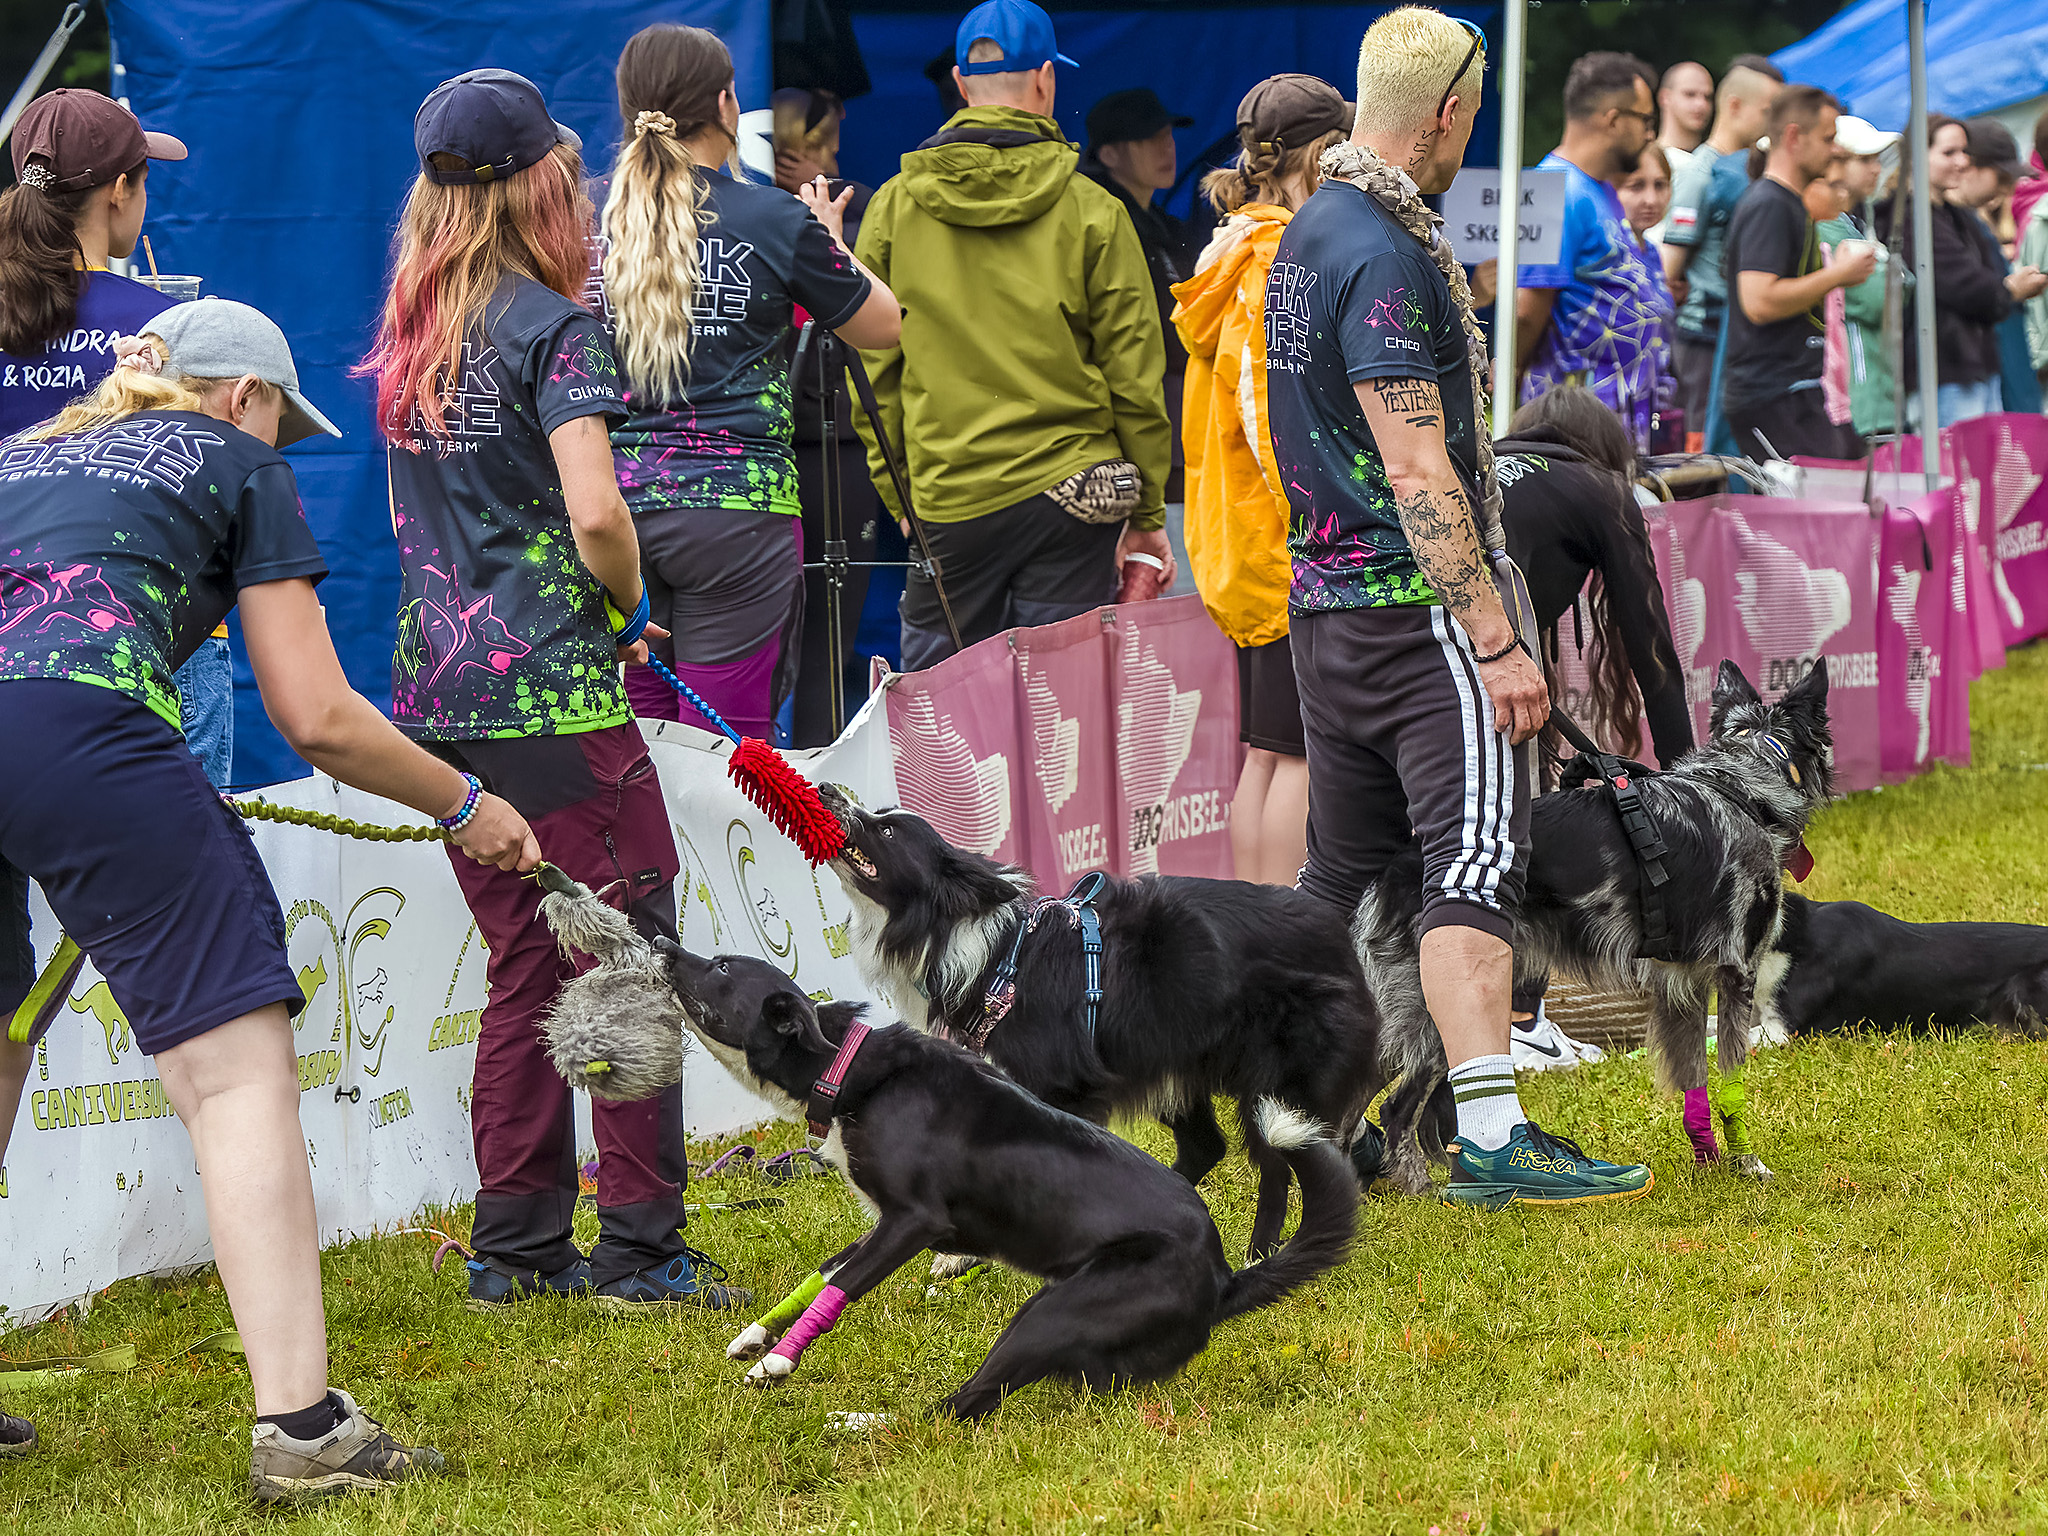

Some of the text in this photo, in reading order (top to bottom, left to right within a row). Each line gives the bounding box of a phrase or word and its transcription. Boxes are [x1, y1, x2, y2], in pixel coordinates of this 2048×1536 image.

[691, 325, 728, 337] EAM
[1384, 336, 1420, 351] Chico
[3, 364, 19, 387] &
[568, 383, 616, 400] Oliwia
[84, 466, 150, 489] TEAM
[1509, 1146, 1577, 1176] HOKA
